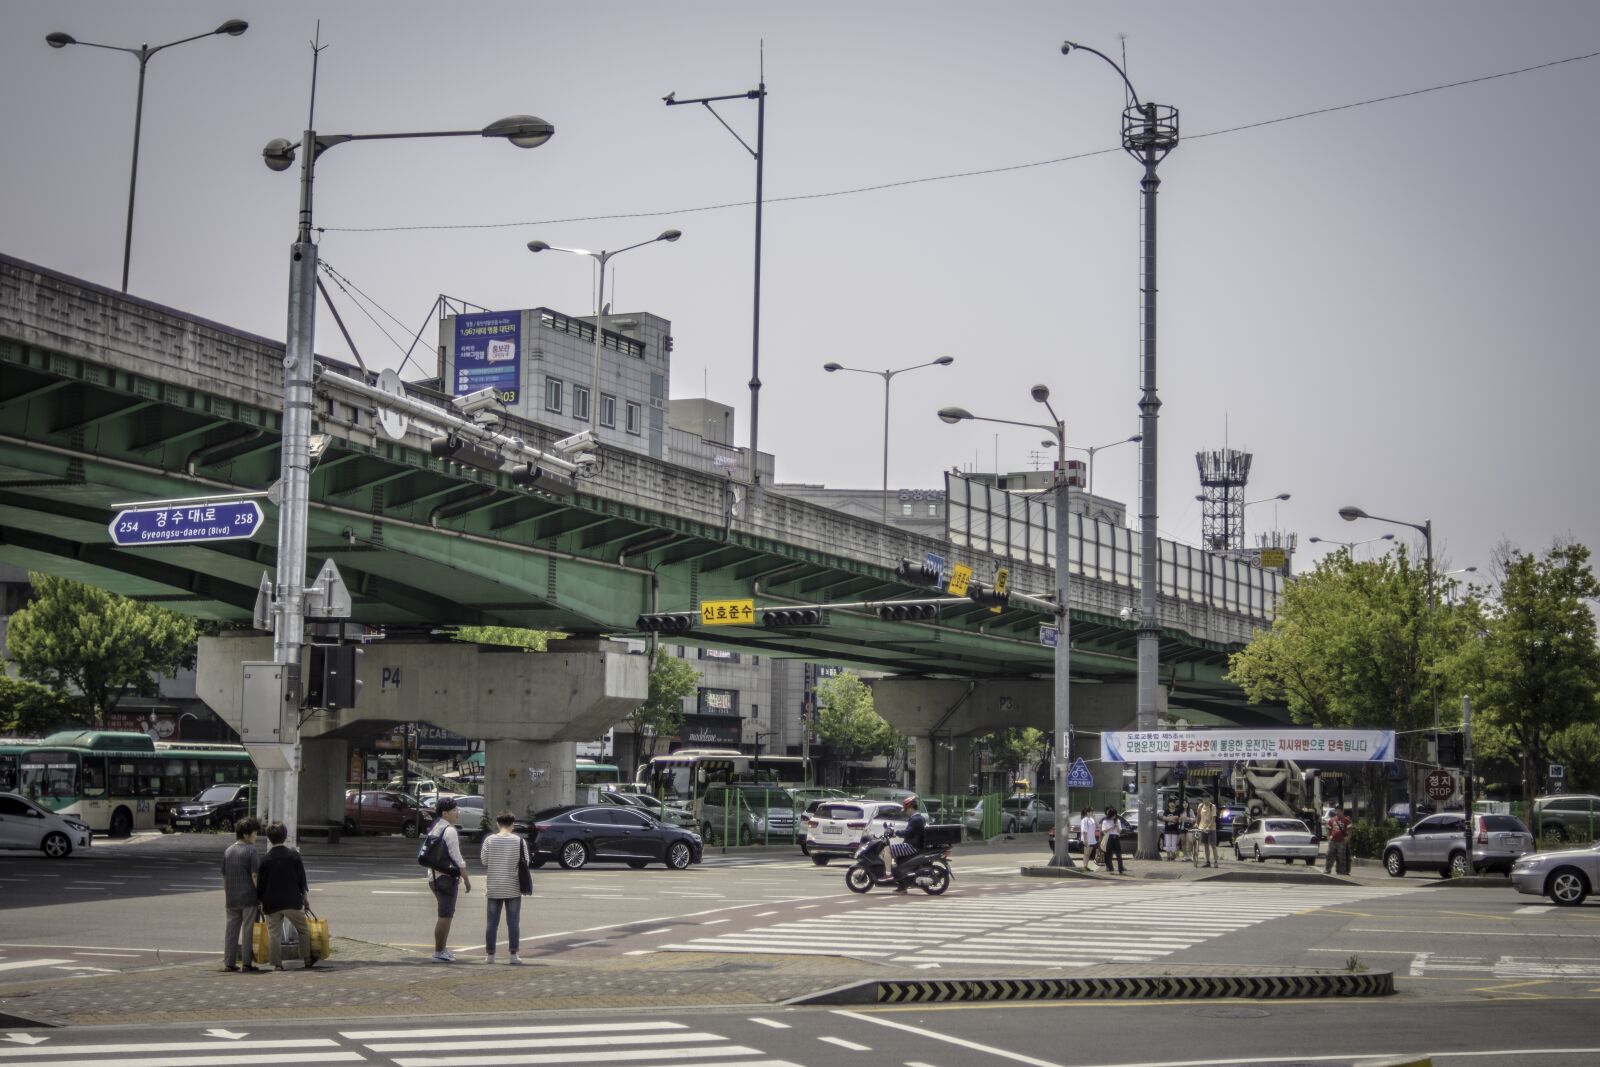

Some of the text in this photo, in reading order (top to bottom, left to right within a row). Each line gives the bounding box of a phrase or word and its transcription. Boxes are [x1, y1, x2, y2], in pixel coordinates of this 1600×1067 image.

[119, 508, 253, 533] 254 경수대로 258
[141, 526, 230, 541] Gyeongsu-daero (Blvd)
[703, 603, 753, 621] 신호준수
[381, 667, 401, 689] P4
[1126, 739, 1368, 753] 모범운전자의 교통수신호에 불응한 운전자는 지시위반으로 단속됩니다
[1429, 775, 1451, 786] 정지
[1429, 787, 1451, 796] STOP
